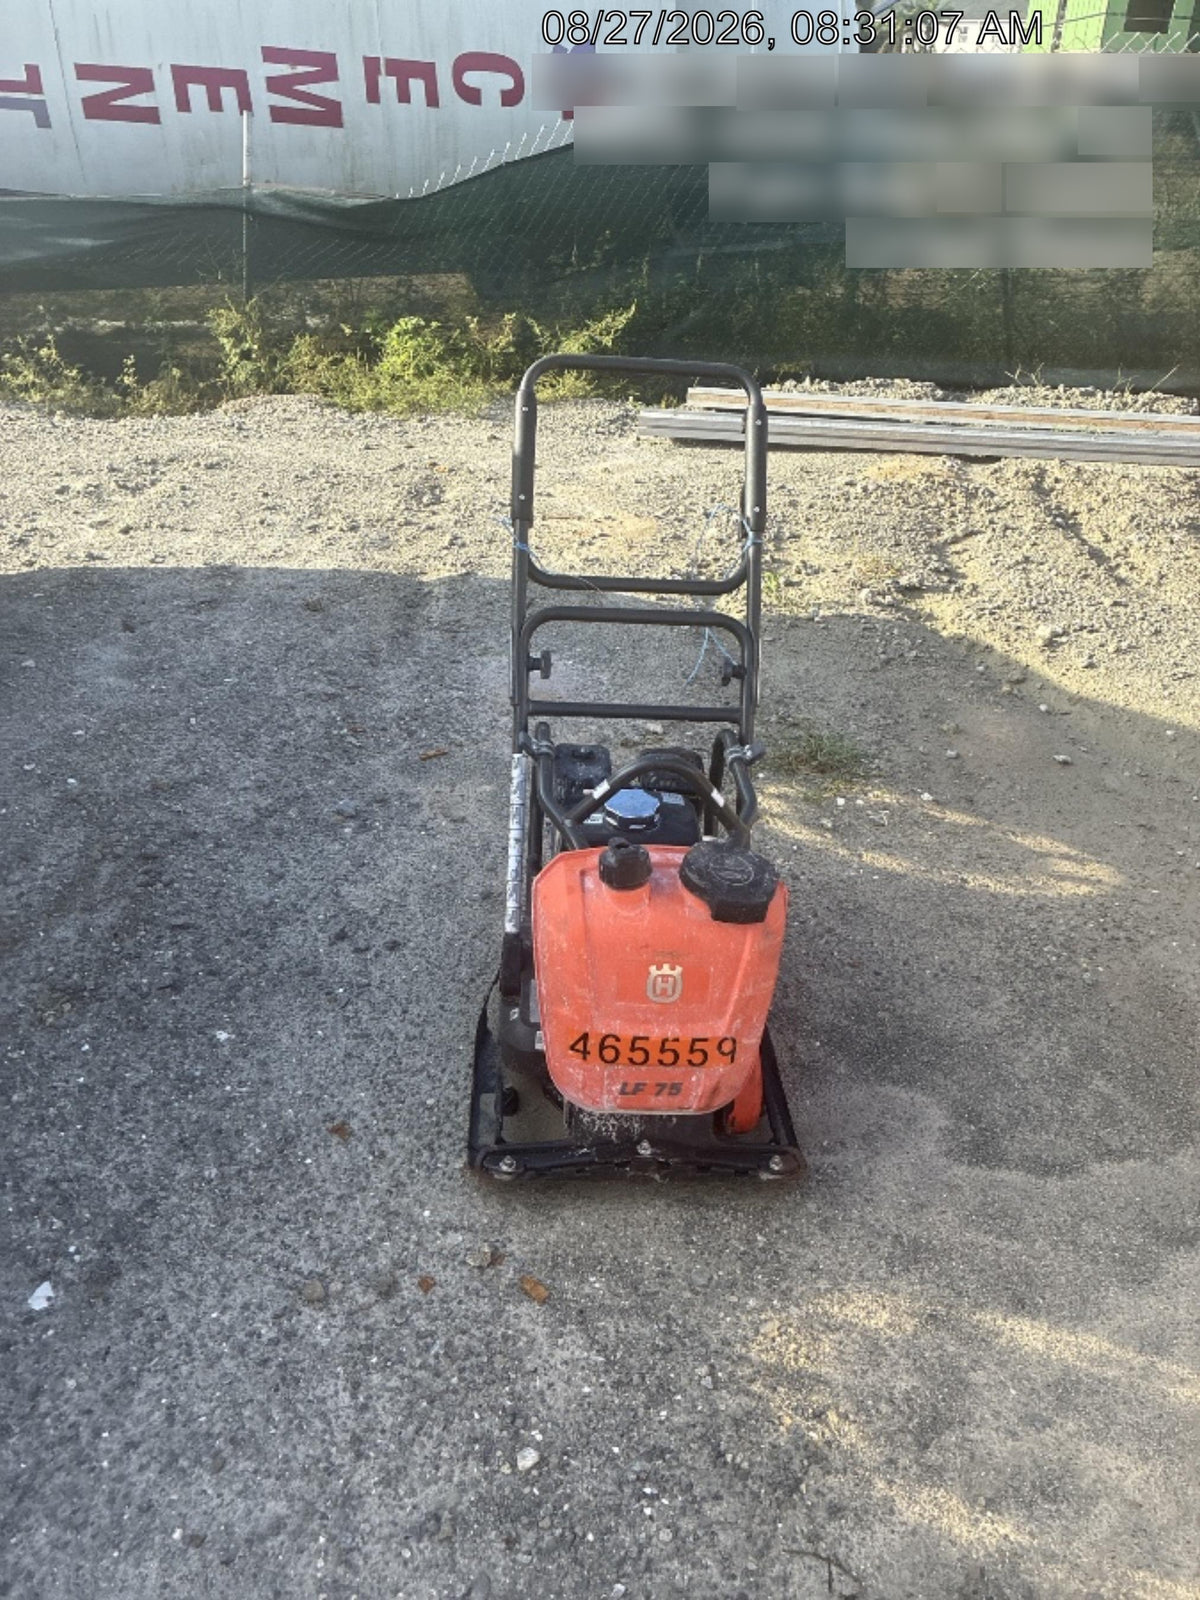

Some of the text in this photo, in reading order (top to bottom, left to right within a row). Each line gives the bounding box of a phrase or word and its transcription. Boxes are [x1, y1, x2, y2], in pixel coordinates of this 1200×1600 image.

[568, 1032, 738, 1067] 465559
[618, 1081, 684, 1096] LF 75
